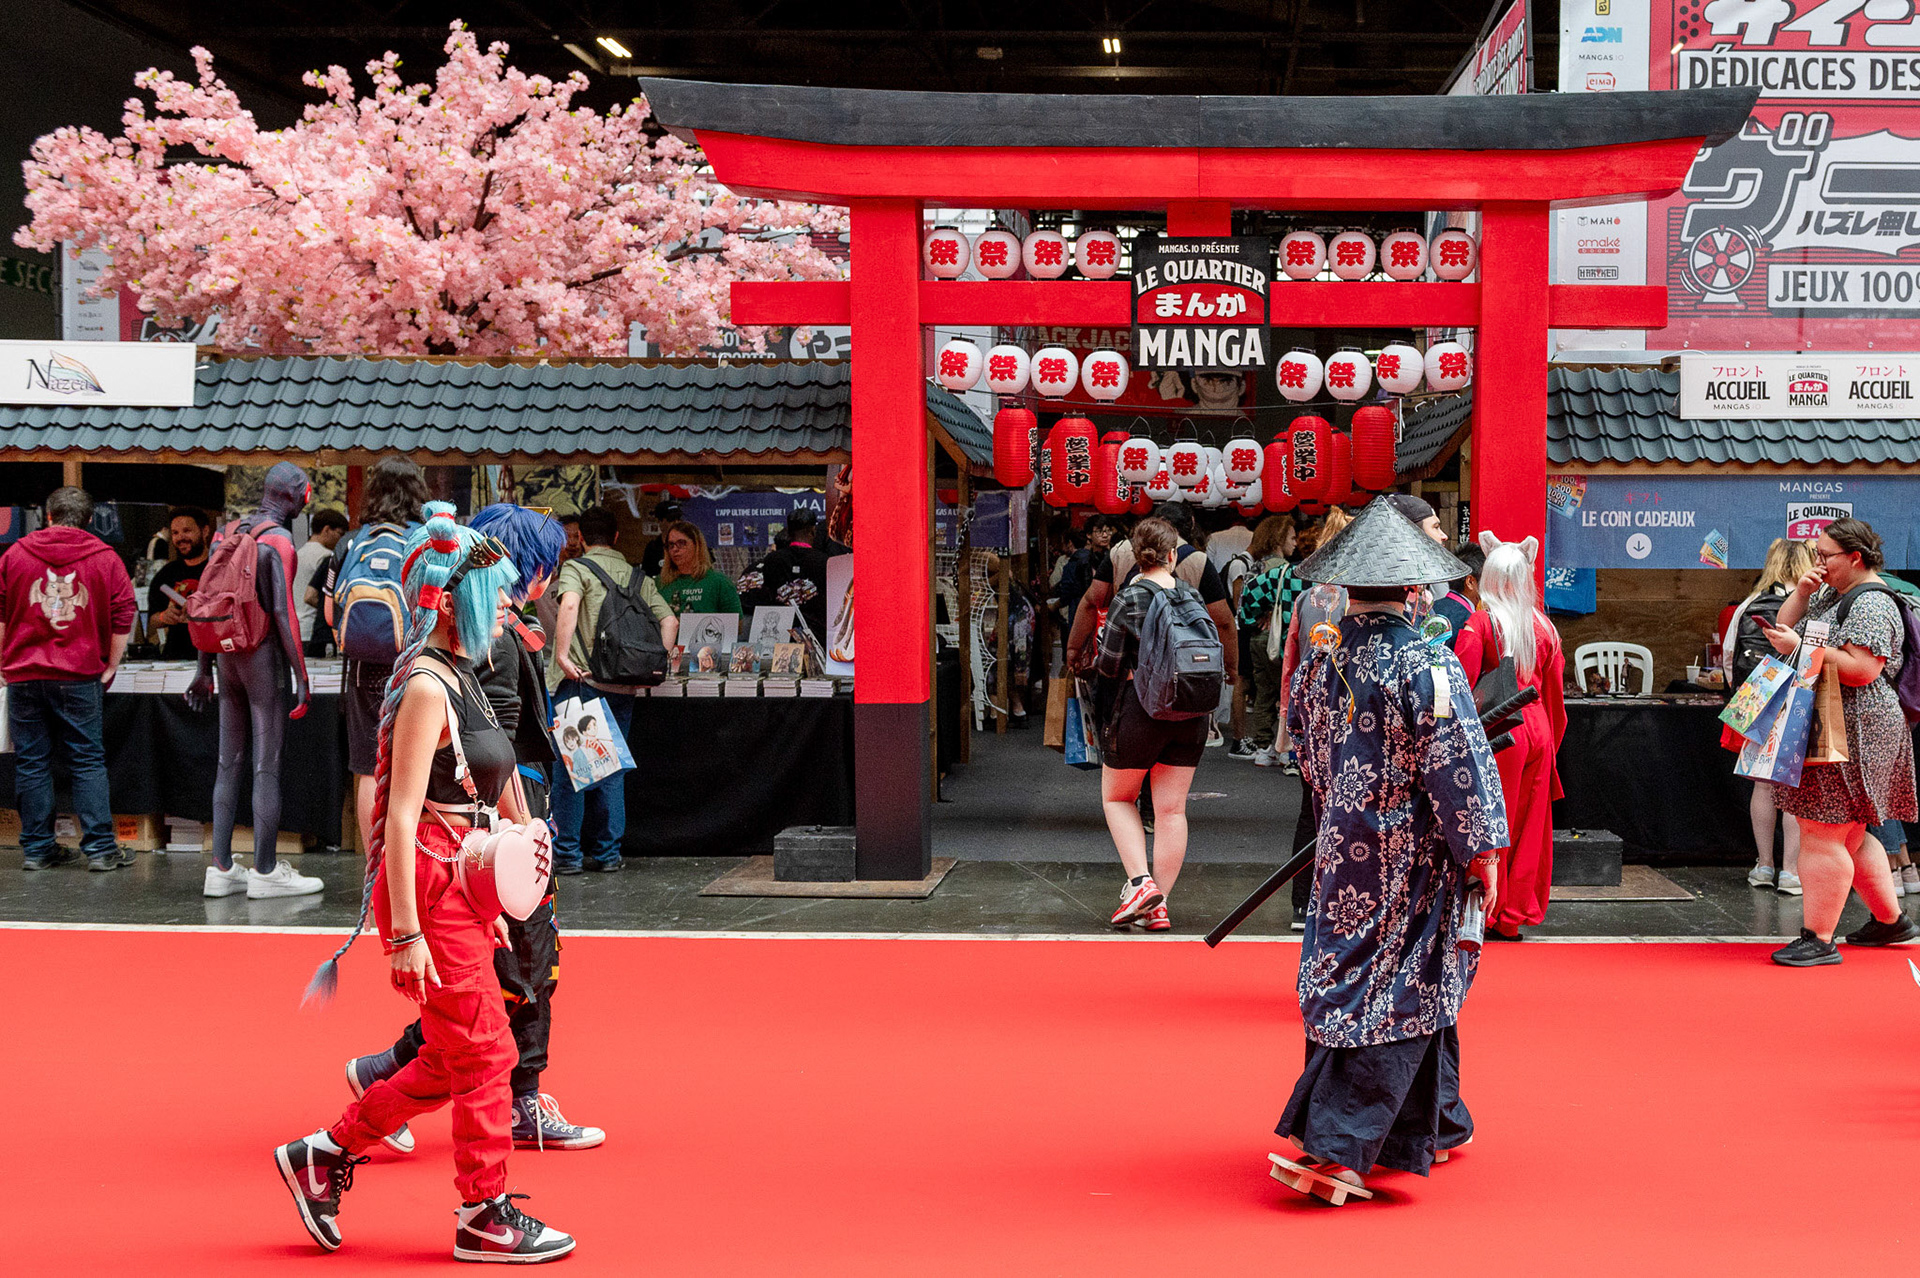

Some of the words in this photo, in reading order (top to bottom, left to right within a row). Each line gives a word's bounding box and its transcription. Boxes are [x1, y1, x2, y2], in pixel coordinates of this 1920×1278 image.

[1581, 27, 1622, 43] ADN
[1689, 41, 1856, 90] DÉDICACES
[930, 239, 959, 266] 祭
[979, 240, 1008, 267] 祭
[1035, 239, 1063, 266] 祭
[1087, 239, 1114, 266] 祭
[1158, 243, 1200, 254] MANGAS.IO
[1201, 241, 1240, 254] PRÉSENTE
[1286, 240, 1316, 266] 祭
[1337, 241, 1366, 267] 祭
[1391, 241, 1420, 268] 祭
[1440, 239, 1469, 267] 祭
[1577, 236, 1621, 247] omaké
[1135, 265, 1159, 295] LE
[1163, 259, 1267, 295] QUARTIER
[1775, 271, 1849, 302] JEUX
[1861, 271, 1920, 302] 100
[1155, 292, 1247, 318] まんが
[1082, 328, 1132, 351] JAC
[1138, 327, 1266, 367] MANGA
[940, 349, 969, 378] 祭
[989, 354, 1018, 382] 祭
[1038, 357, 1068, 384] 祭
[1091, 360, 1121, 388] 祭
[1280, 360, 1307, 389] 祭
[1328, 361, 1356, 388] 祭
[1377, 353, 1400, 379] 祭
[1438, 352, 1467, 379] 祭
[1712, 365, 1763, 378] フロント
[1789, 374, 1796, 382] LE
[1797, 371, 1829, 382] QUARTIER
[1856, 365, 1907, 377] フロント
[1705, 381, 1770, 400] ACCUEIL
[1789, 394, 1828, 406] MANGA
[1849, 380, 1914, 400] ACCUEIL
[1123, 446, 1149, 471] 祭
[1172, 451, 1199, 476] 祭
[1231, 447, 1257, 472] 祭
[1555, 483, 1571, 495] 500
[1624, 491, 1662, 505] ギフト
[1779, 482, 1844, 493] MANGAS
[1582, 510, 1597, 527] LE
[1600, 510, 1631, 527] COIN
[1635, 510, 1695, 528] CADEAUX
[1789, 509, 1800, 522] LE
[1802, 505, 1851, 519] QUARTIER
[1796, 523, 1822, 537] まん
